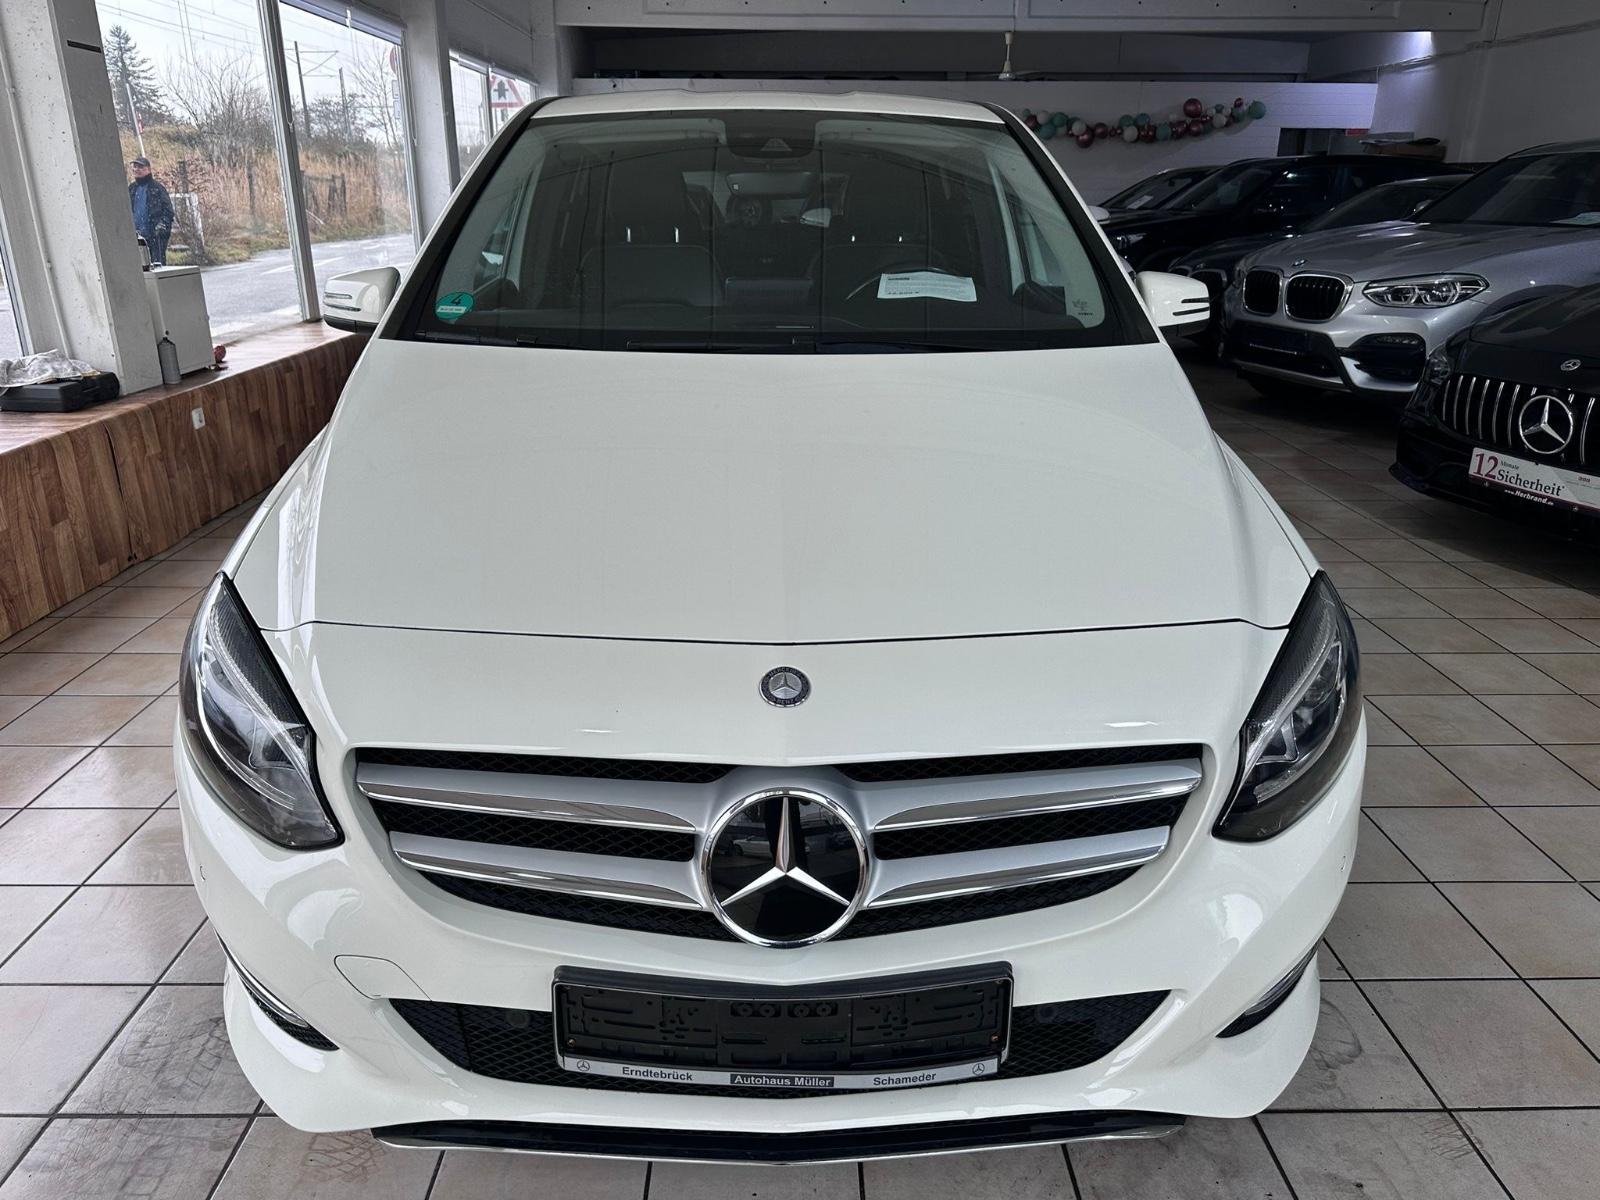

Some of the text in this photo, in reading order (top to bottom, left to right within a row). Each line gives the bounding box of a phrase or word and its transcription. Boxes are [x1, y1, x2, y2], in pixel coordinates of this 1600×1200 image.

[450, 293, 462, 306] 4
[1473, 453, 1499, 480] 12
[622, 1066, 693, 1081] Erndtebrück
[873, 1072, 936, 1086] Schameder
[734, 1075, 831, 1087] Autohaus Müller
